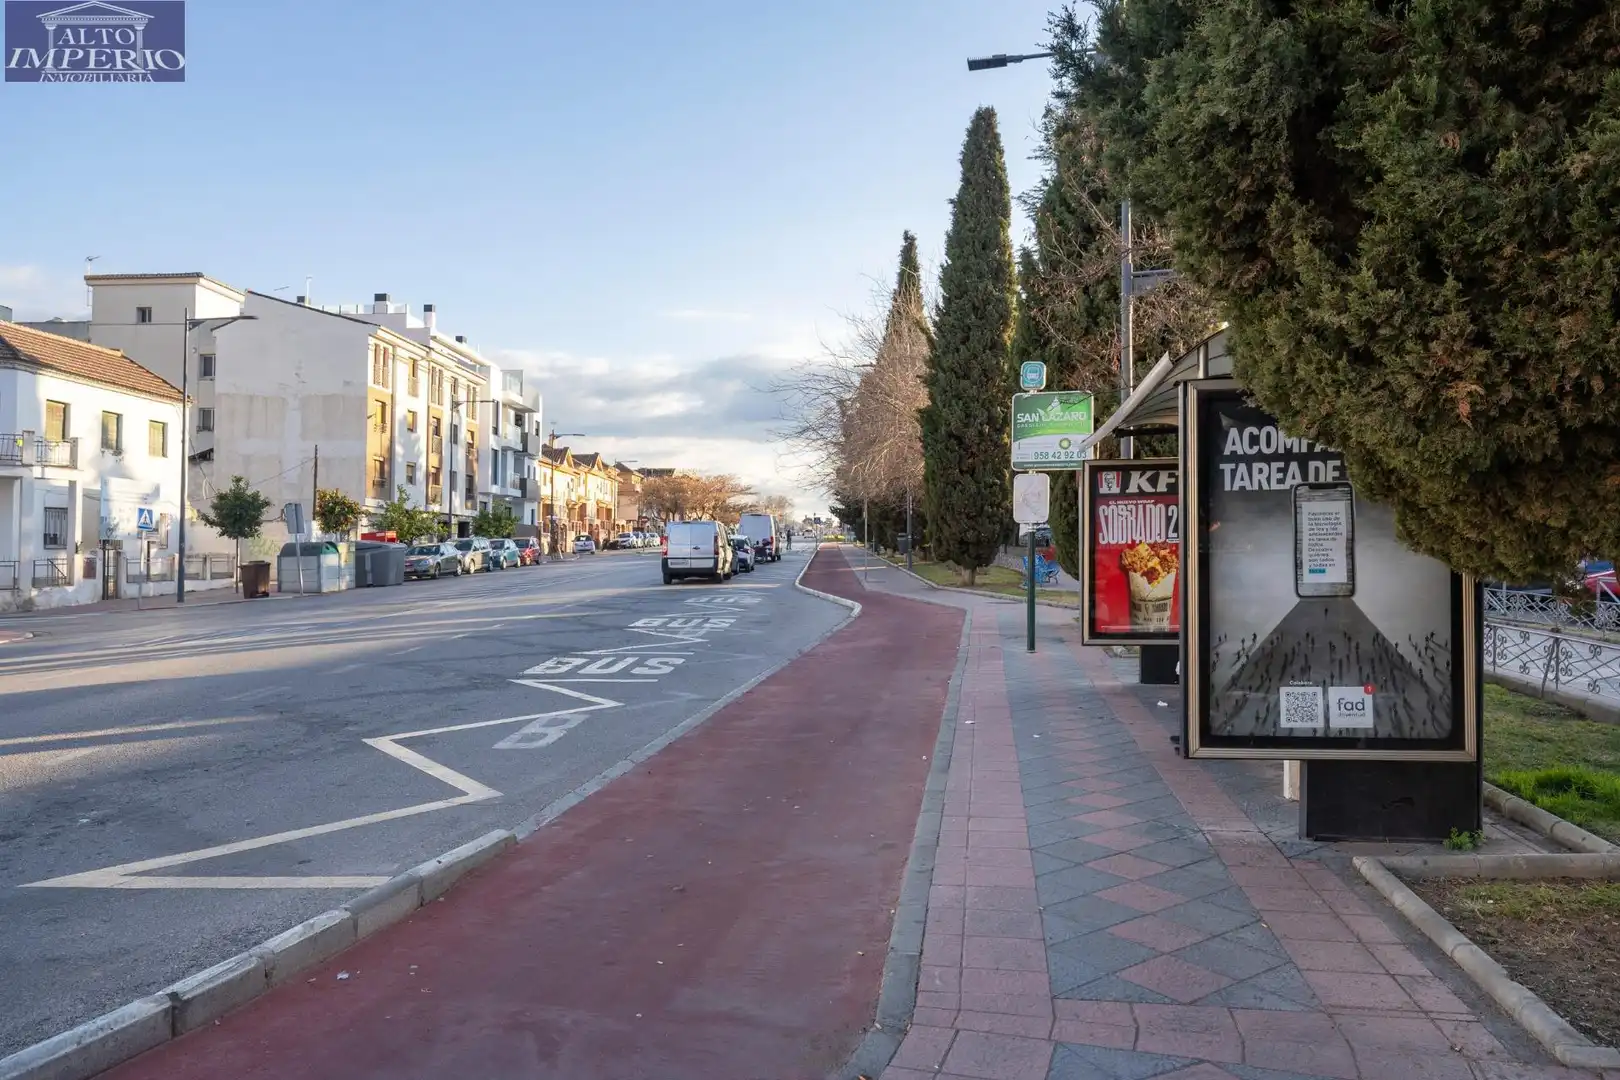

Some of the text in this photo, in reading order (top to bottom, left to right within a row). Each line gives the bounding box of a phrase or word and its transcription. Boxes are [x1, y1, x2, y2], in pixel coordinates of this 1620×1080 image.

[1017, 412, 1040, 423] SAN
[1223, 425, 1342, 455] ACOM
[1033, 451, 1050, 460] 958
[1051, 451, 1062, 460] 42
[1064, 451, 1075, 459] 92
[1076, 450, 1087, 459] 03
[1219, 459, 1341, 491] TAREA DE
[628, 617, 737, 628] BUS
[521, 656, 686, 675] BUS
[1337, 697, 1366, 712] fad
